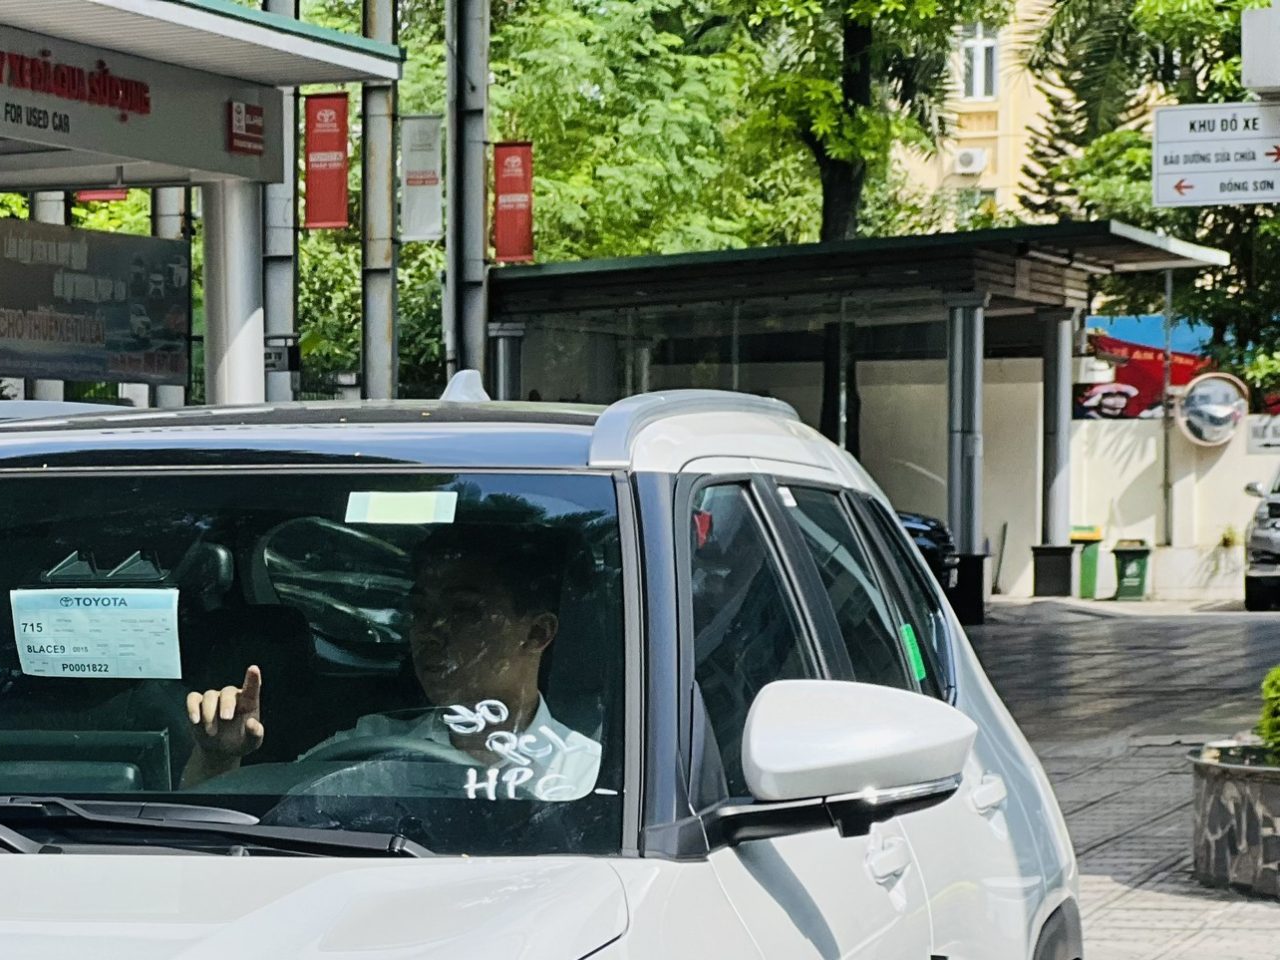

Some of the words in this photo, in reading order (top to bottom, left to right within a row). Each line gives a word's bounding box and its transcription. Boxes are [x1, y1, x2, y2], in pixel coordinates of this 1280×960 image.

[4, 102, 23, 124] FOR
[25, 106, 50, 129] USED
[51, 111, 70, 133] CAR
[1189, 119, 1216, 133] KHU
[1243, 117, 1260, 131] XE
[74, 597, 128, 607] TOYOTA
[21, 622, 43, 633] 715
[62, 663, 109, 673] P0001822
